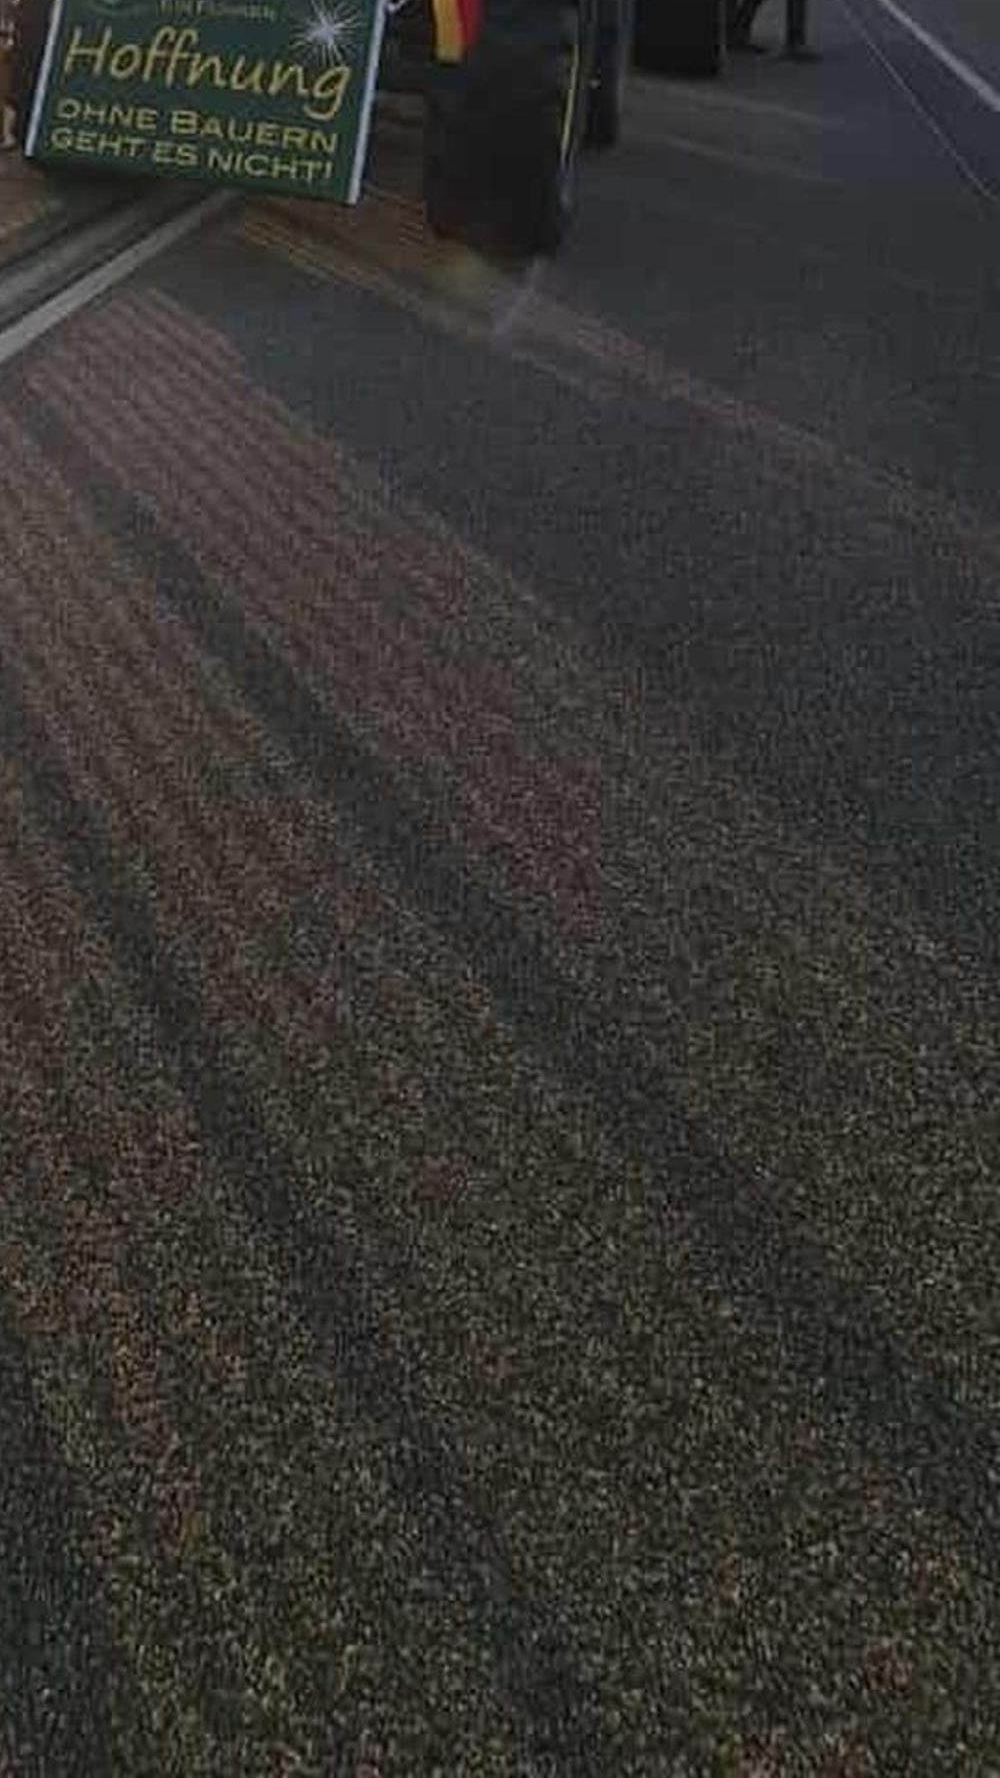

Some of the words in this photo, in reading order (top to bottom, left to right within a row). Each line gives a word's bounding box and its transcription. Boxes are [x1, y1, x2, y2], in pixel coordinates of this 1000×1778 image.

[63, 25, 352, 120] Hoffnung
[57, 98, 159, 131] OHNE
[171, 109, 338, 154] BAUERN
[51, 127, 146, 158] GEHT
[152, 140, 200, 167] ES
[207, 148, 333, 184] NICHT!
